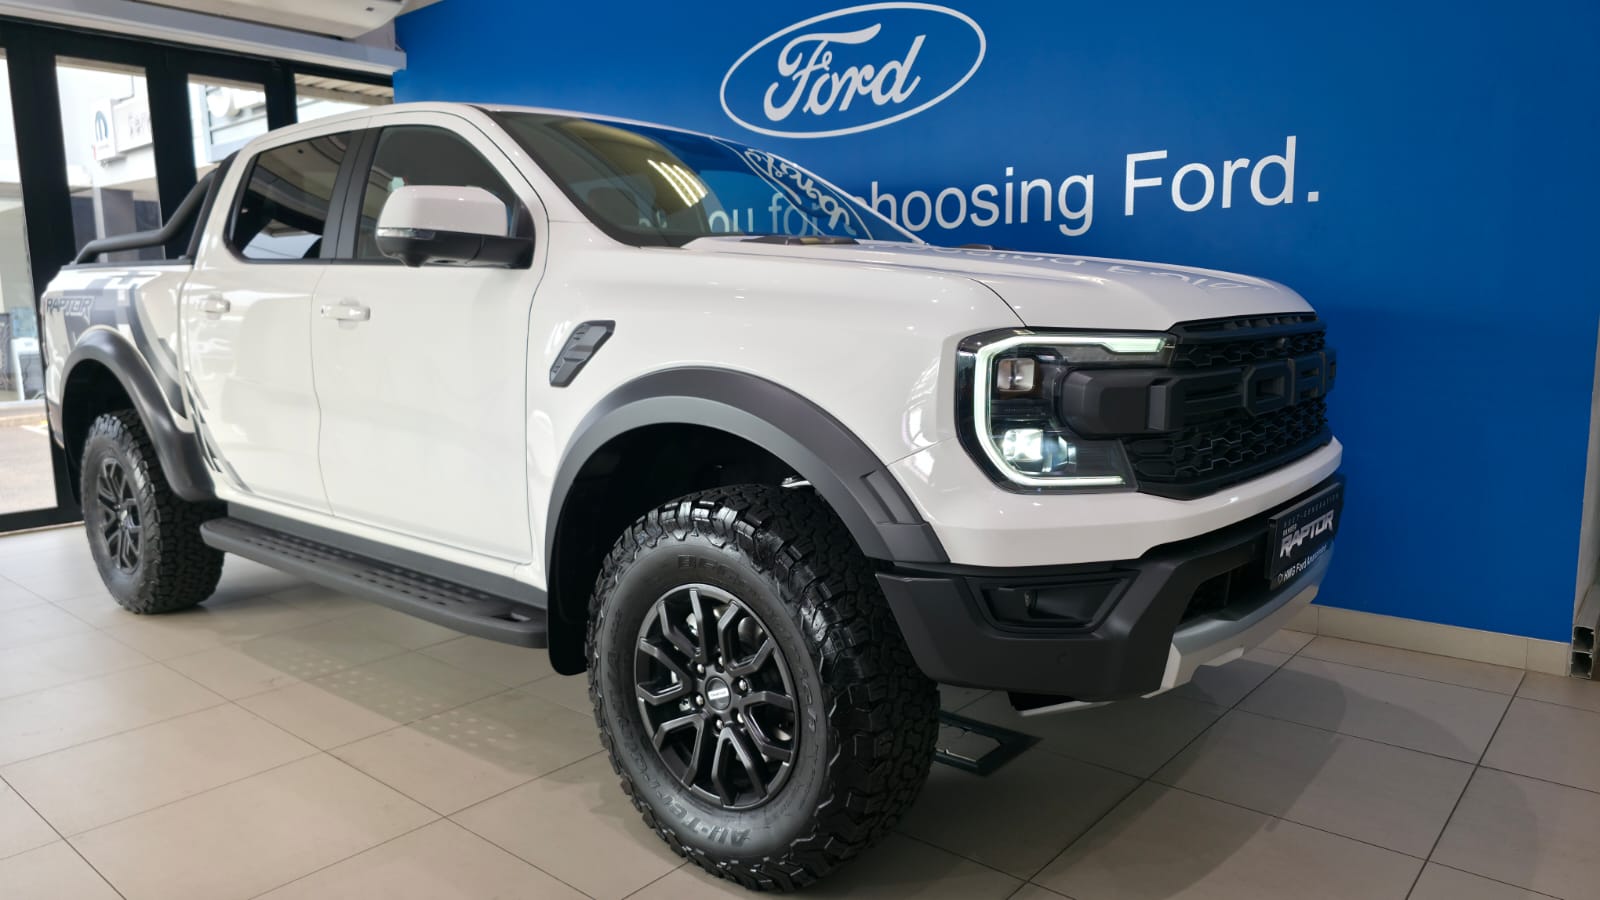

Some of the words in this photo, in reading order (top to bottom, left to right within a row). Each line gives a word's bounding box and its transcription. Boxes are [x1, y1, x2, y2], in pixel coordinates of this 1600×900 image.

[763, 23, 926, 122] Ford
[852, 168, 1095, 237] hoosing
[1124, 135, 1320, 217] Ford.
[46, 297, 95, 324] RAPTOR
[1280, 509, 1335, 558] RAPTOR
